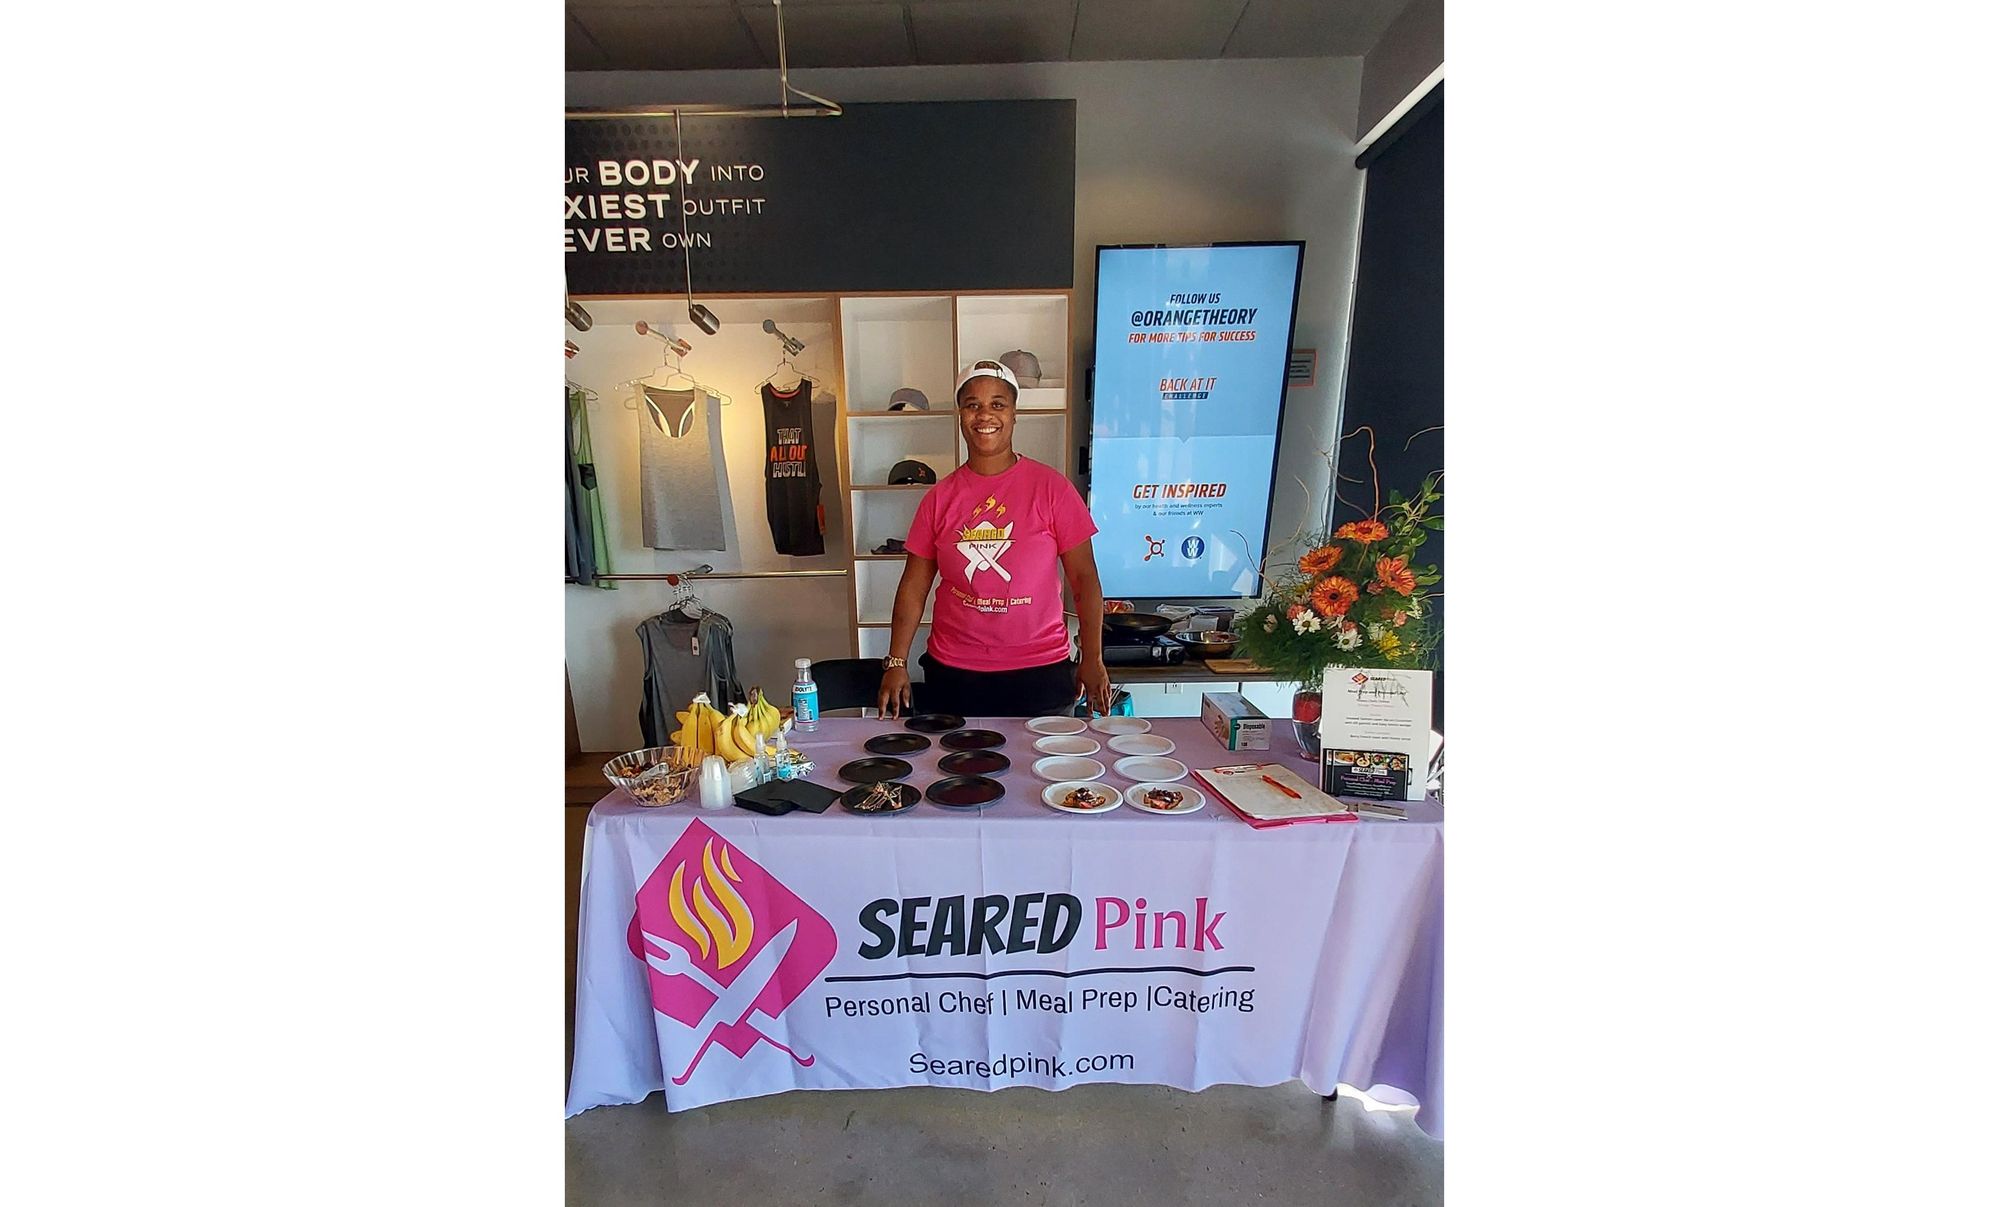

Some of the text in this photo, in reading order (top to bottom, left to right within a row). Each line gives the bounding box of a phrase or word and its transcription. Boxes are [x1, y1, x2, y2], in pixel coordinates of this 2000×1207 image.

[598, 159, 700, 186] BODY
[711, 165, 764, 181] INTO
[565, 193, 766, 219] XIEST OUTFIT
[565, 227, 712, 252] EVER OWN
[1169, 293, 1221, 304] FOLLOW US
[1131, 308, 1258, 327] @ORANGETHEORY
[1128, 333, 1146, 343] FOR
[1148, 332, 1174, 343] MORE
[1199, 331, 1217, 342] FOR
[1219, 330, 1257, 341] SUCCESS
[1160, 377, 1217, 391] BACK AT IT
[1133, 483, 1227, 499] GET INSPIRED
[992, 598, 1005, 606] Prep
[858, 892, 1228, 960] SEARED Pink
[825, 991, 931, 1018] Personal
[938, 990, 994, 1015] Chef
[1016, 989, 1073, 1014] Meal
[1082, 988, 1138, 1013] Prep
[909, 1051, 1135, 1079] Searedpink.com
